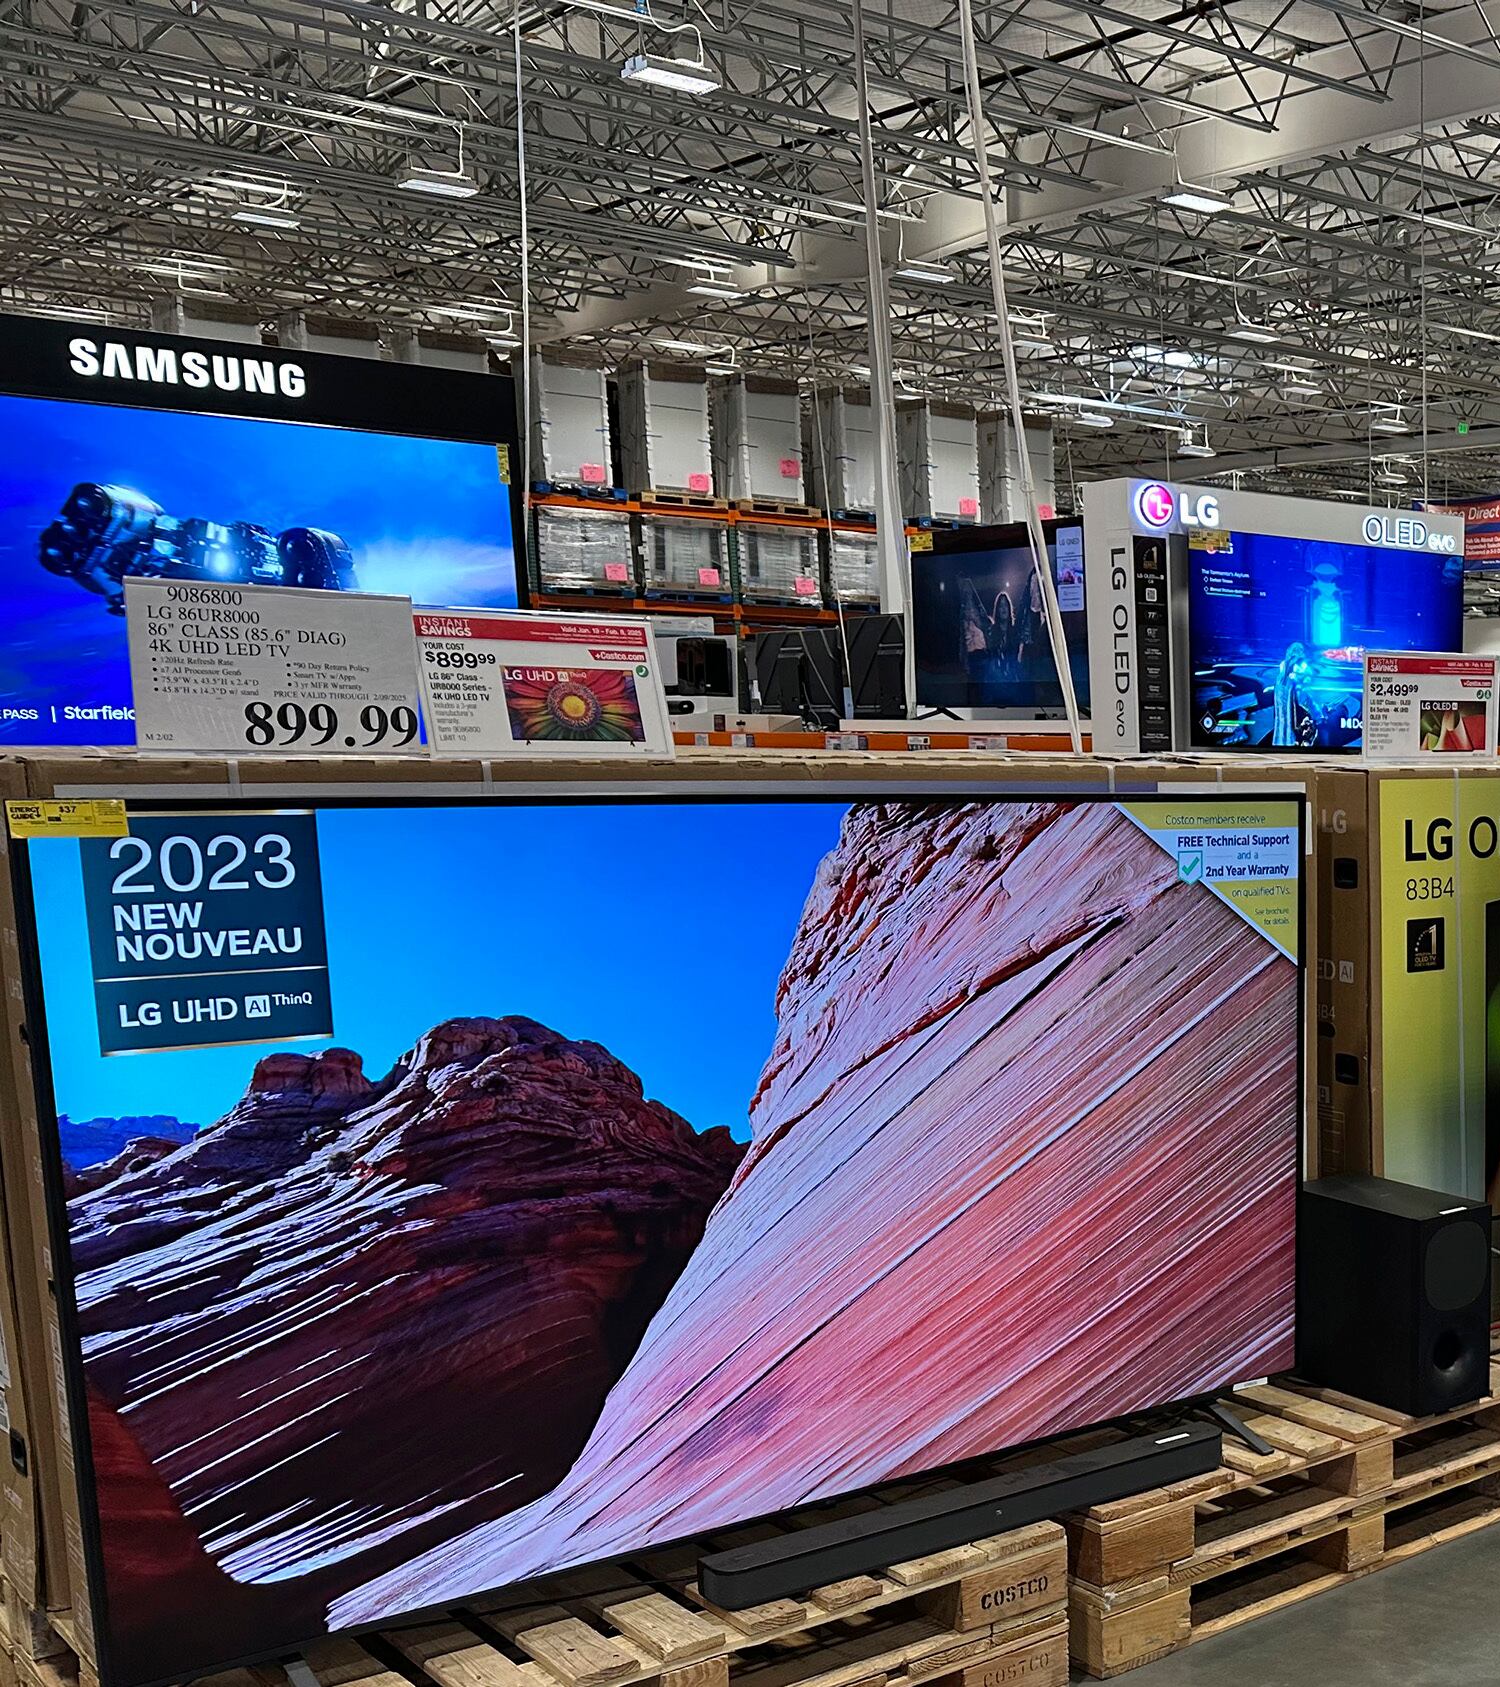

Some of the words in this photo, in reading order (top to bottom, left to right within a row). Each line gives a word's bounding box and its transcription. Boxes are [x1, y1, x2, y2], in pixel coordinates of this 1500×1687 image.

[68, 337, 306, 398] SAMSUNG
[1180, 493, 1219, 527] LG
[1468, 504, 1500, 520] Direct
[1363, 515, 1427, 549] OLED
[1428, 533, 1456, 552] evo
[1111, 547, 1127, 590] LG
[167, 586, 243, 606] 9086800
[147, 605, 172, 619] LG
[178, 607, 260, 625] 86UR8000
[419, 616, 469, 628] INSTANT
[148, 622, 174, 636] 86"
[181, 624, 239, 640] CLASS
[245, 627, 291, 642] (85.6"
[298, 629, 347, 647] DIAG)
[421, 625, 472, 637] SAVINGS
[149, 639, 172, 653] 4K
[179, 640, 219, 654] UHD
[226, 642, 261, 657] LED
[266, 644, 290, 658] TV
[423, 642, 443, 650] YOUR
[1112, 604, 1130, 694] OLED
[187, 657, 216, 666] Refresh
[218, 658, 234, 666] Rate
[308, 663, 321, 672] Day
[324, 664, 347, 672] Return
[349, 665, 370, 674] Policy
[1370, 665, 1399, 673] SAVINGS
[184, 667, 220, 676] Processor
[317, 672, 327, 680] TV
[429, 672, 440, 680] LG
[457, 673, 478, 681] Class
[505, 671, 523, 680] LG
[527, 671, 554, 682] UHD
[311, 682, 329, 690] MFR
[331, 683, 362, 692] Warranty
[463, 683, 487, 692] Series
[273, 689, 297, 699] PRICE
[300, 690, 327, 700] VALID
[329, 691, 369, 701] THROUGH
[463, 693, 478, 701] LED
[3, 709, 39, 719] PASS
[1421, 702, 1431, 710] LG
[1432, 702, 1451, 711] OLED
[244, 702, 418, 747] 899.99
[1115, 699, 1125, 737] evo
[1165, 814, 1195, 826] Costco
[1196, 813, 1235, 825] members
[1237, 813, 1266, 824] receive
[1321, 808, 1348, 834] LG
[1177, 836, 1203, 848] FREE
[1206, 834, 1249, 847] Technical
[1252, 834, 1290, 848] Support
[1404, 817, 1454, 862] LG
[1237, 851, 1252, 860] and
[109, 834, 296, 894] 2023
[1206, 866, 1224, 877] 2nd
[1226, 865, 1246, 876] Year
[1248, 863, 1290, 876] Warranty
[1231, 889, 1242, 897] on
[1242, 886, 1275, 899] qualified
[1406, 876, 1454, 900] 83B4
[113, 902, 204, 932] NEW
[116, 927, 302, 962] NOUVEAU
[119, 1003, 162, 1028] LG
[172, 997, 238, 1023] UHD
[272, 991, 313, 1006] ThinQ
[980, 1575, 1049, 1610] COSTCO
[983, 1653, 1049, 1687] COSTCO
